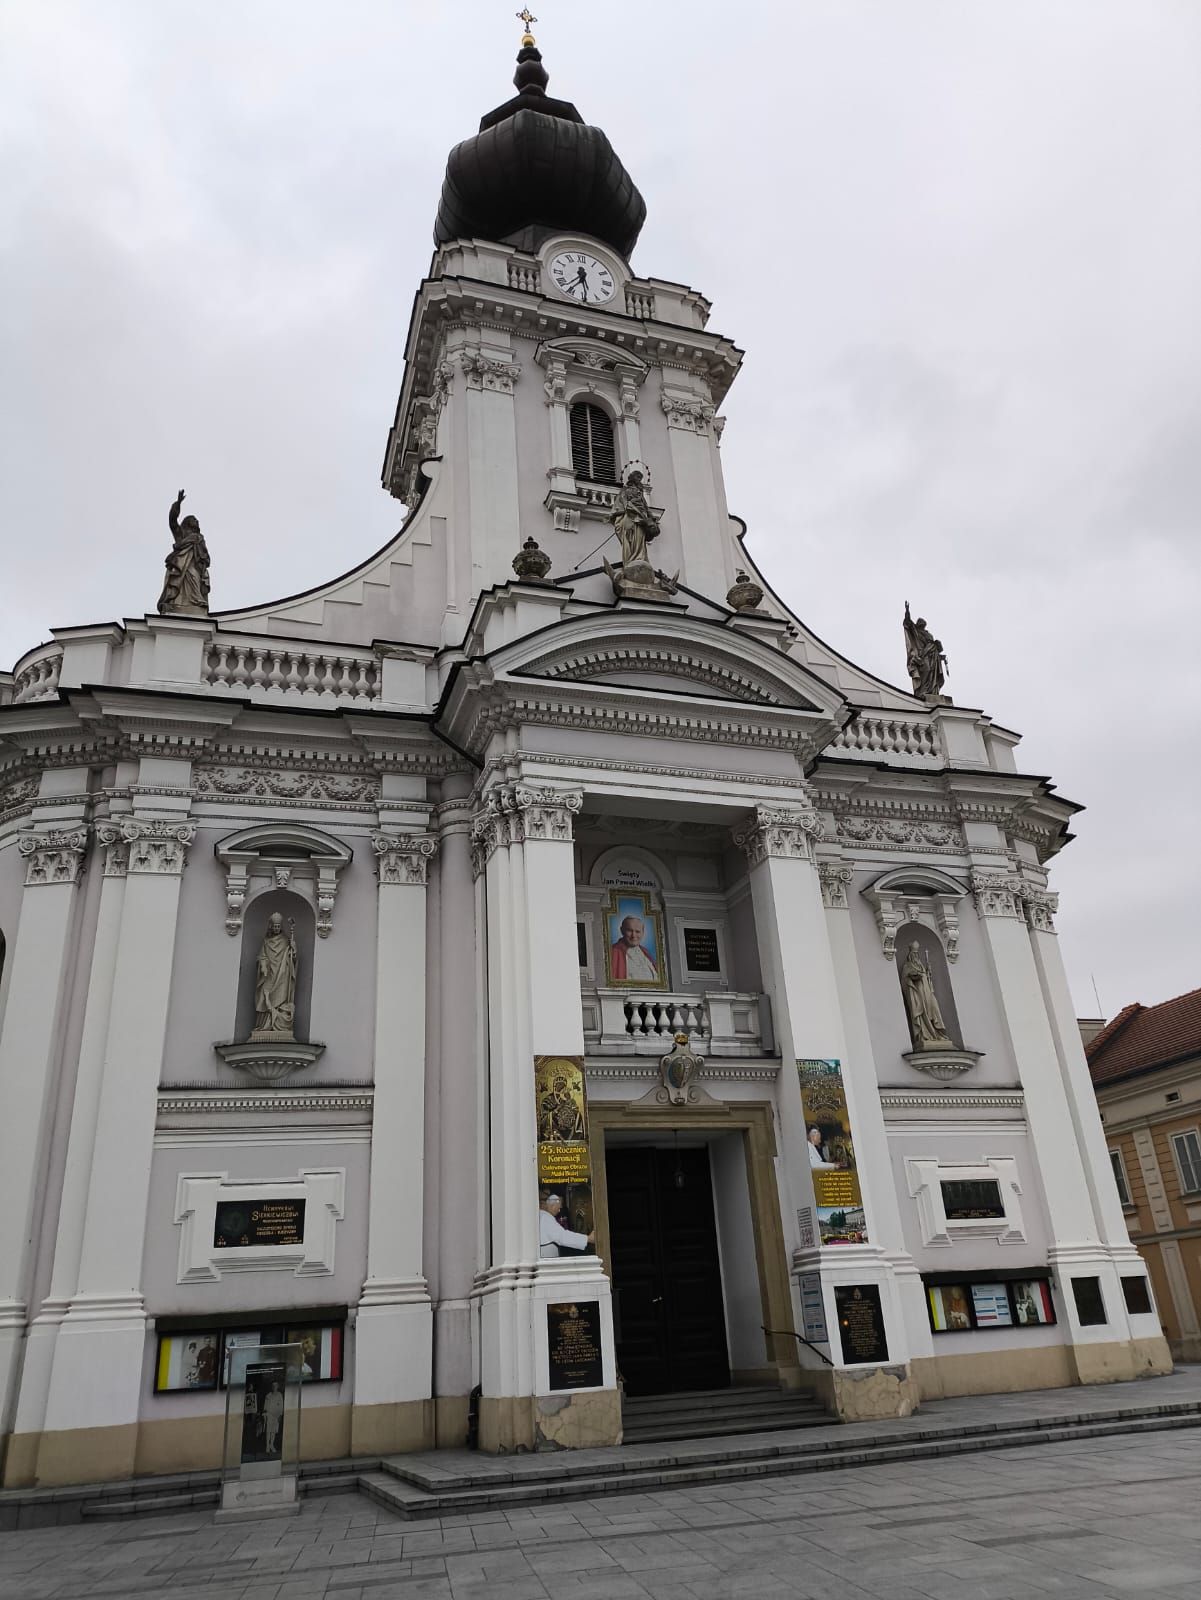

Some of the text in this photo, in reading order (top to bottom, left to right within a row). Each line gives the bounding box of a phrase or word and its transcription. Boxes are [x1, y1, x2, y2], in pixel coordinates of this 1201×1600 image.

[577, 255, 586, 264] XII
[541, 1146, 587, 1154] 25. Rocznica
[548, 1154, 581, 1163] Koronacji
